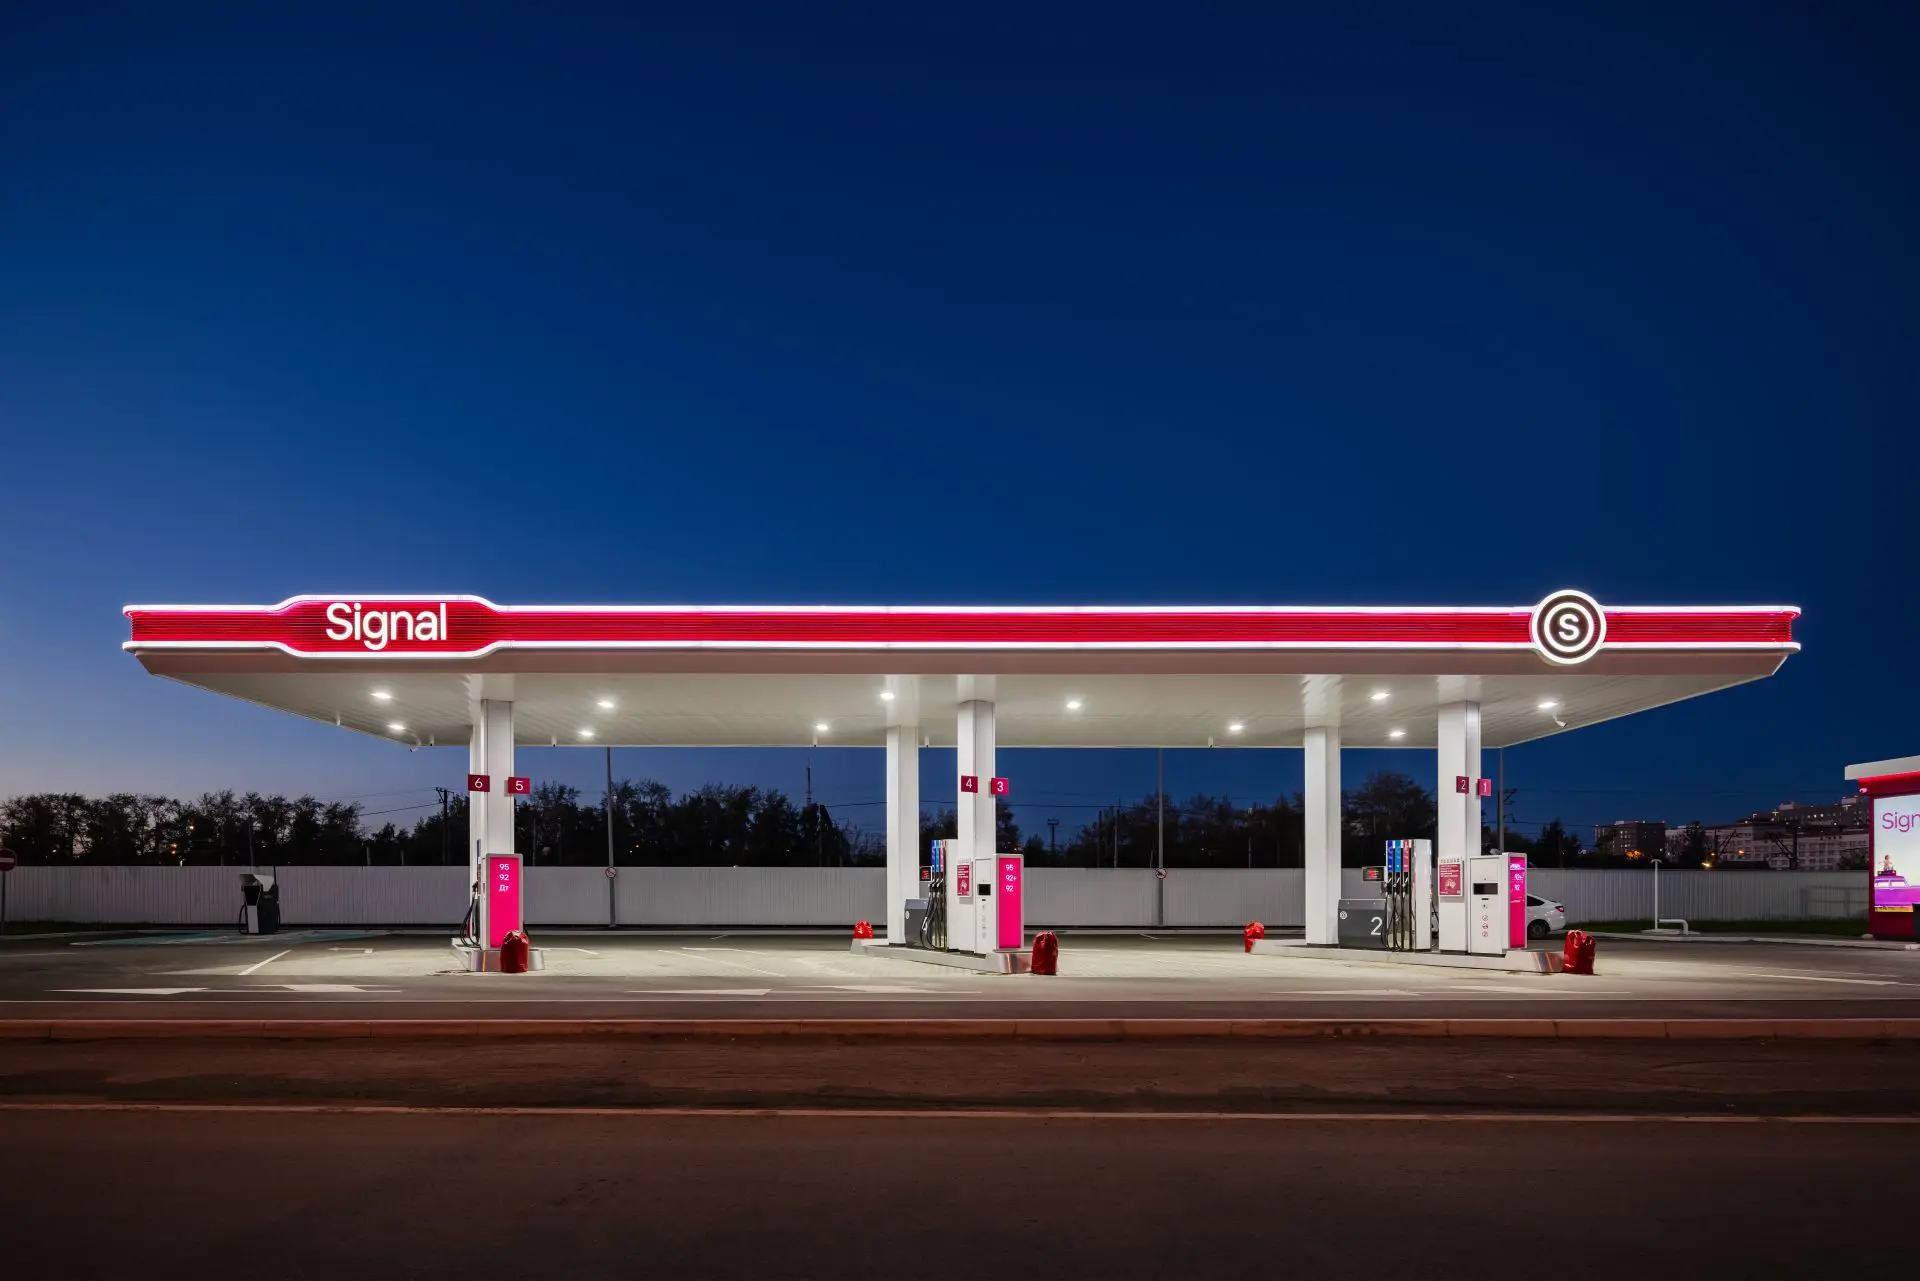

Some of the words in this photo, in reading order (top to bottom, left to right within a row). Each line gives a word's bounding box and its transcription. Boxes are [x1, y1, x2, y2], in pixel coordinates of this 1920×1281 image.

[326, 602, 447, 650] Signal
[1558, 613, 1580, 641] S
[475, 777, 483, 788] 6
[515, 780, 523, 791] 5
[966, 778, 972, 789] 4
[997, 781, 1004, 792] 3
[1461, 779, 1466, 790] 2
[1483, 782, 1487, 793] 1
[499, 863, 510, 871] 95
[1005, 874, 1017, 882] 92+
[1370, 916, 1383, 935] 2
